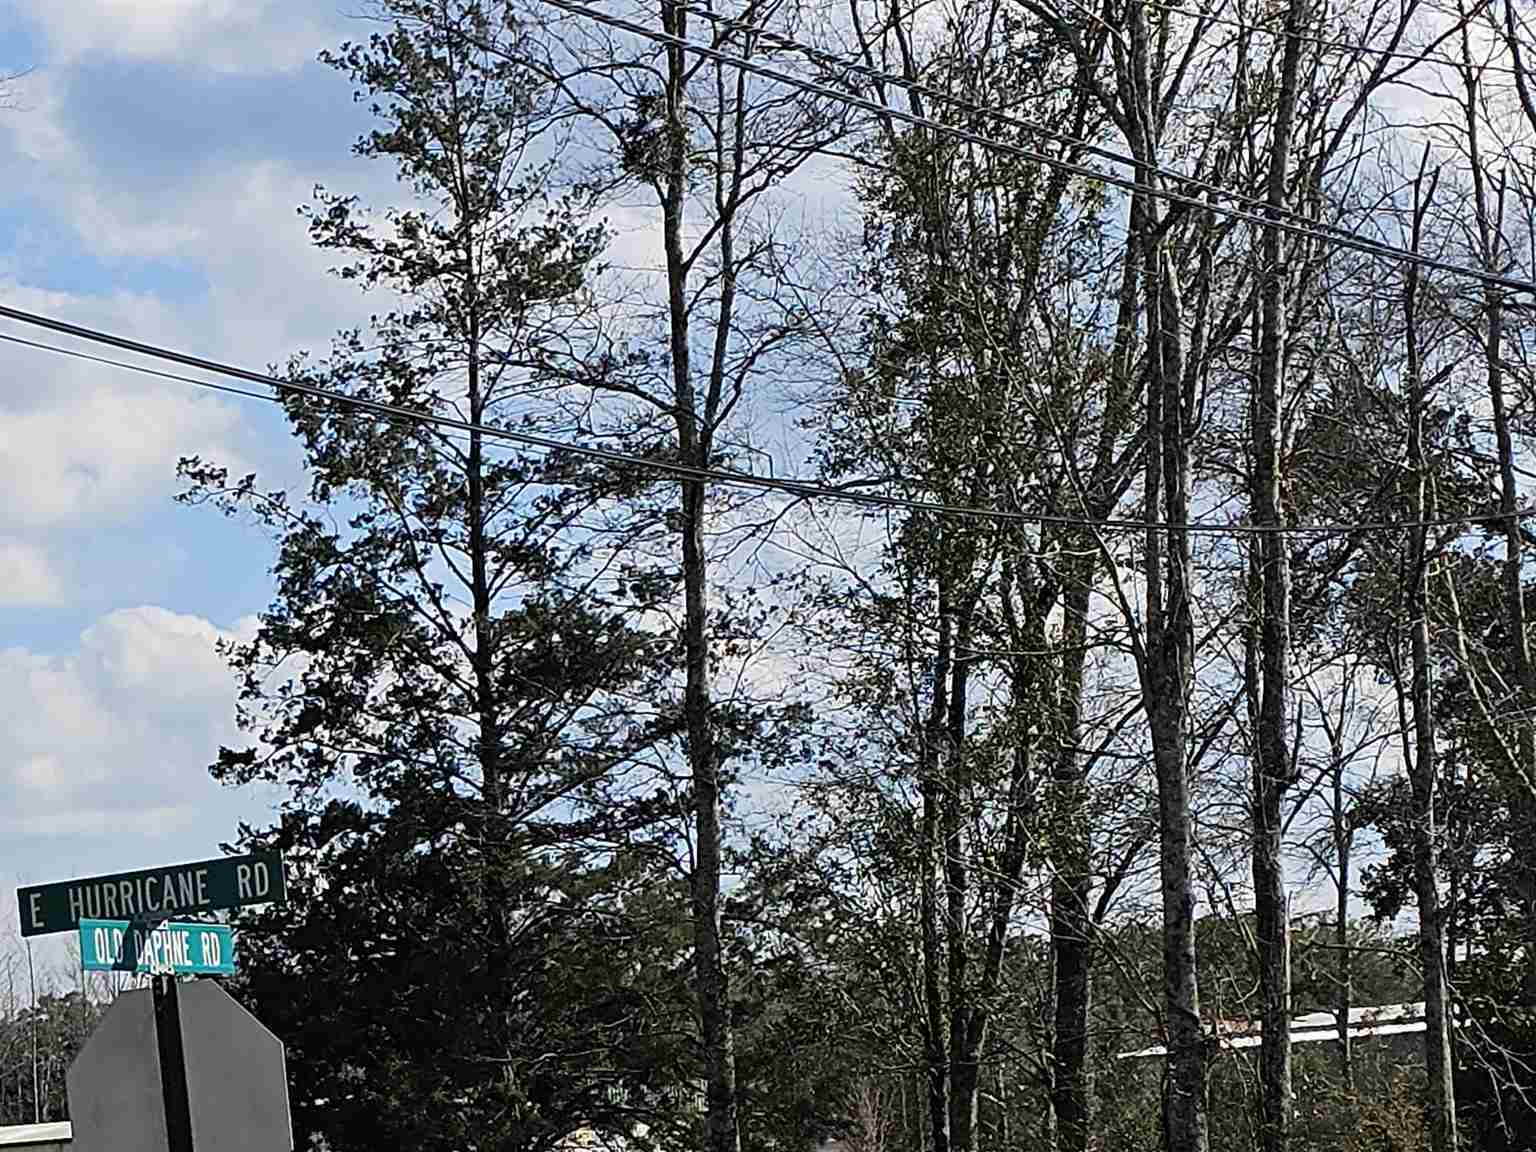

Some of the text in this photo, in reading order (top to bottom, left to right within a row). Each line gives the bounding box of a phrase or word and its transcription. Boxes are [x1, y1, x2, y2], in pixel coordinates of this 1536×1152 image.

[29, 862, 270, 928] E HURRICANE RD
[94, 927, 221, 967] OLD DAPHNE RD
